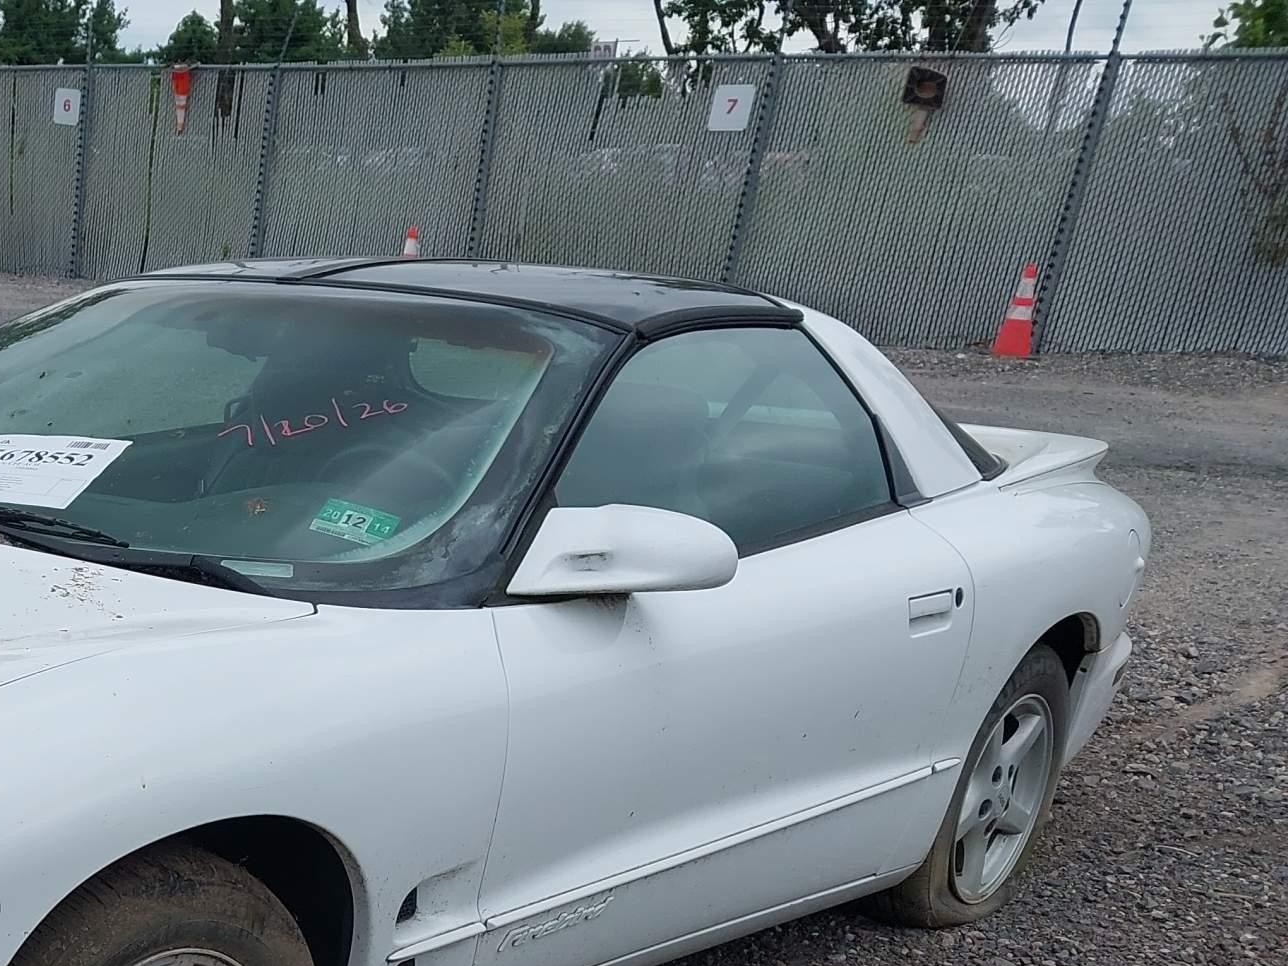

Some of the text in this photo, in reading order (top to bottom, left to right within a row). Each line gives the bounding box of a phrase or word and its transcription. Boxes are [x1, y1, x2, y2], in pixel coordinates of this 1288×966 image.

[63, 98, 71, 112] 6
[726, 98, 738, 115] 7
[322, 508, 342, 521] 20
[342, 512, 368, 530] 12
[496, 887, 617, 953] Firebird
